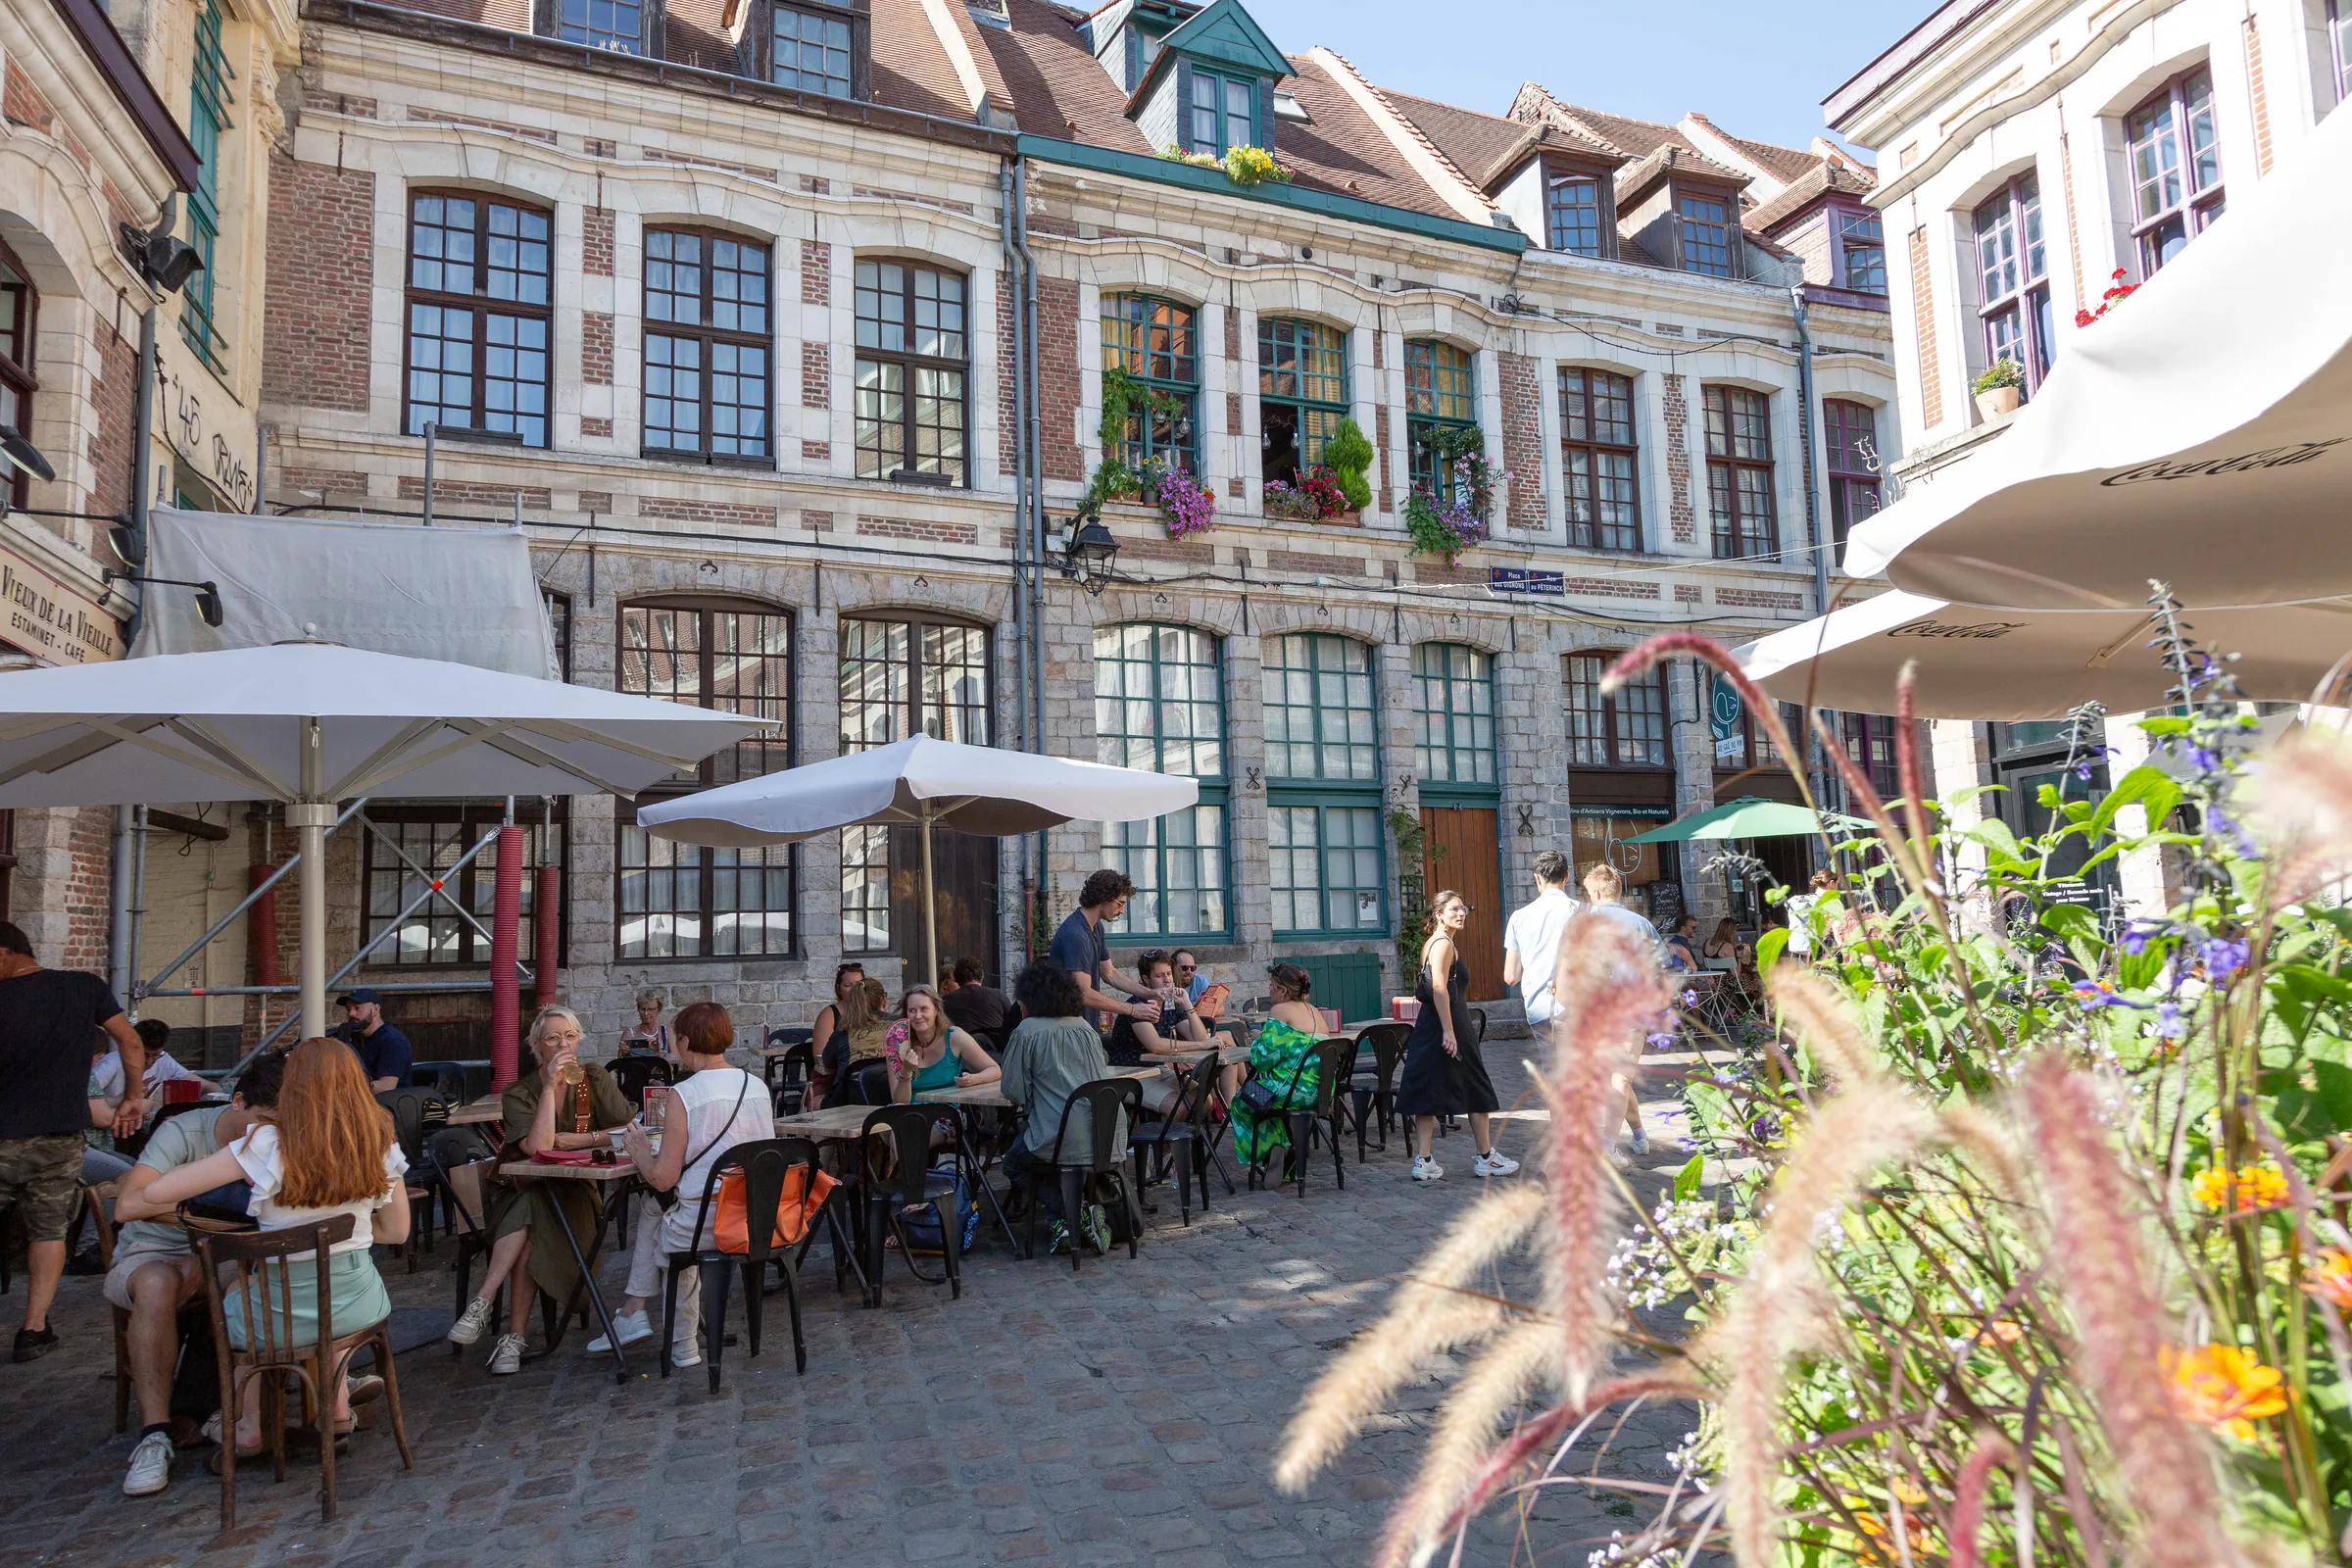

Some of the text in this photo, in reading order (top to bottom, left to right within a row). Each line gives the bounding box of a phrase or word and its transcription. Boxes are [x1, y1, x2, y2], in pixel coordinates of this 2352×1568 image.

[2100, 437, 2352, 486] Coca-Cola
[1537, 583, 1563, 592] PÉTERINCK
[11, 612, 56, 648] ESTAMINET
[38, 597, 55, 623] DE
[57, 608, 73, 634] LA
[76, 610, 113, 656] VIEILLE
[1886, 619, 2033, 638] Coca-Cola
